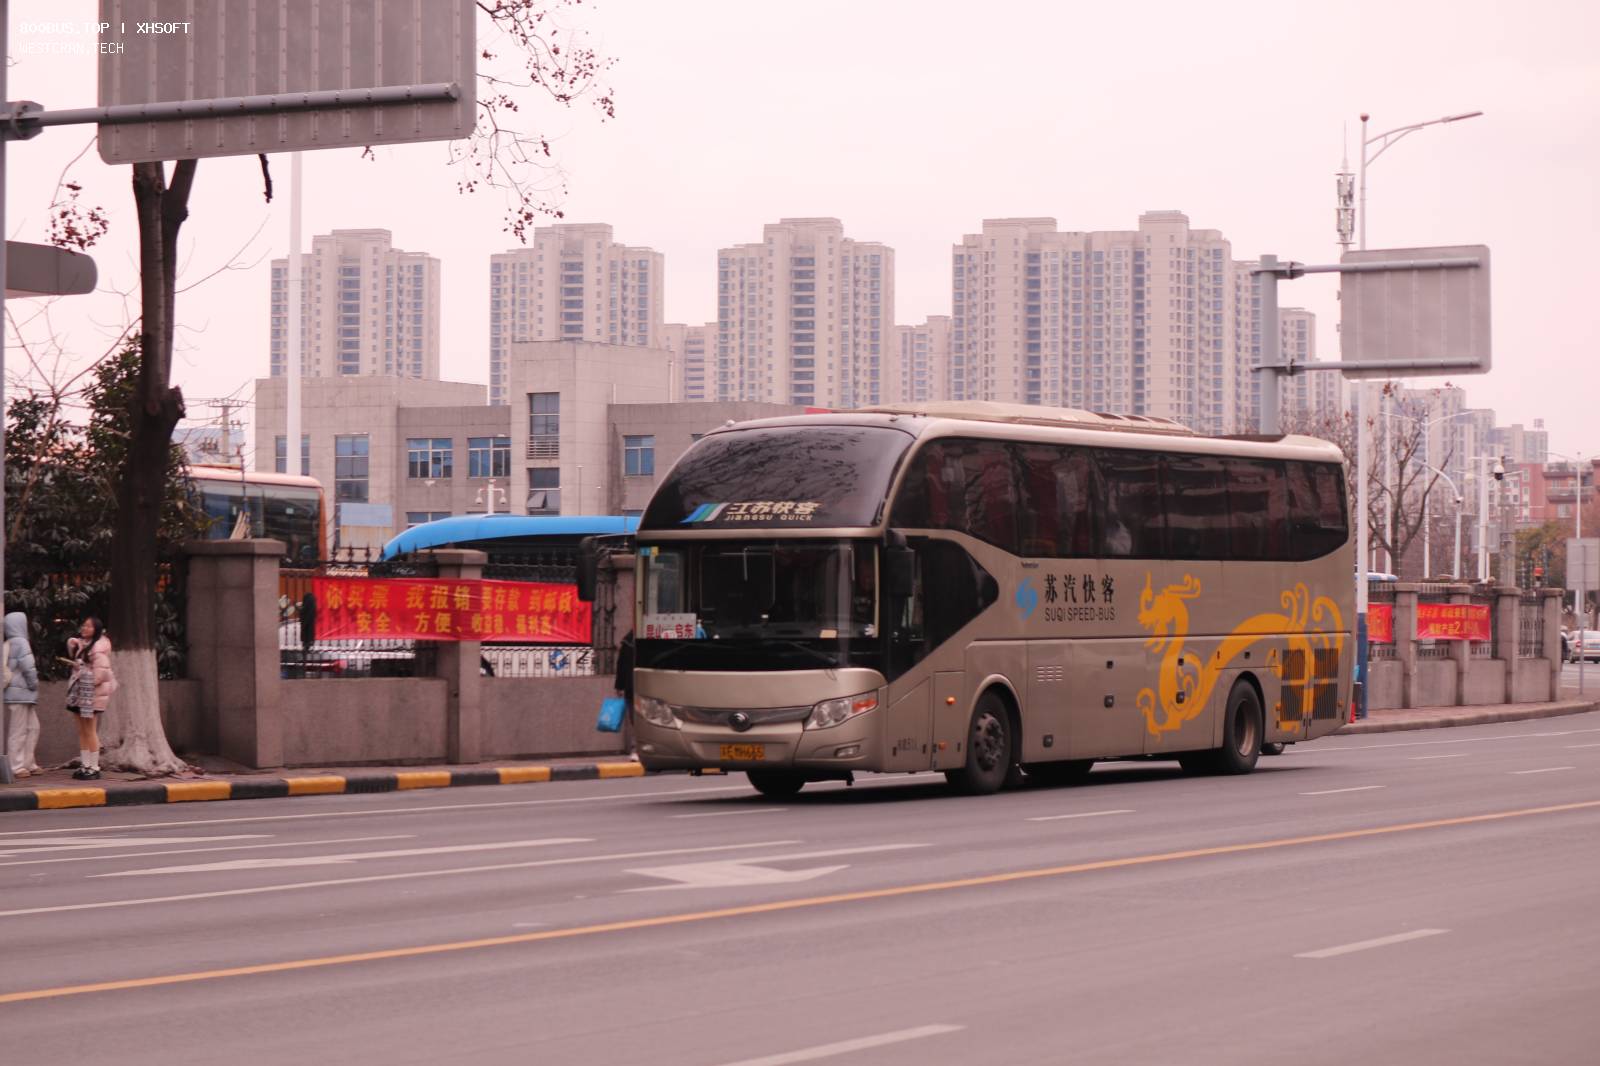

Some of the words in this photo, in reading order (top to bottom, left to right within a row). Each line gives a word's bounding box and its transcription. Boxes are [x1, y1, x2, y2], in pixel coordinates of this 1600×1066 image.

[727, 501, 820, 514] 江苏快客
[326, 584, 389, 609] 你买票
[1044, 573, 1114, 604] 苏汽快客
[1067, 607, 1116, 621] SPEED-BUS
